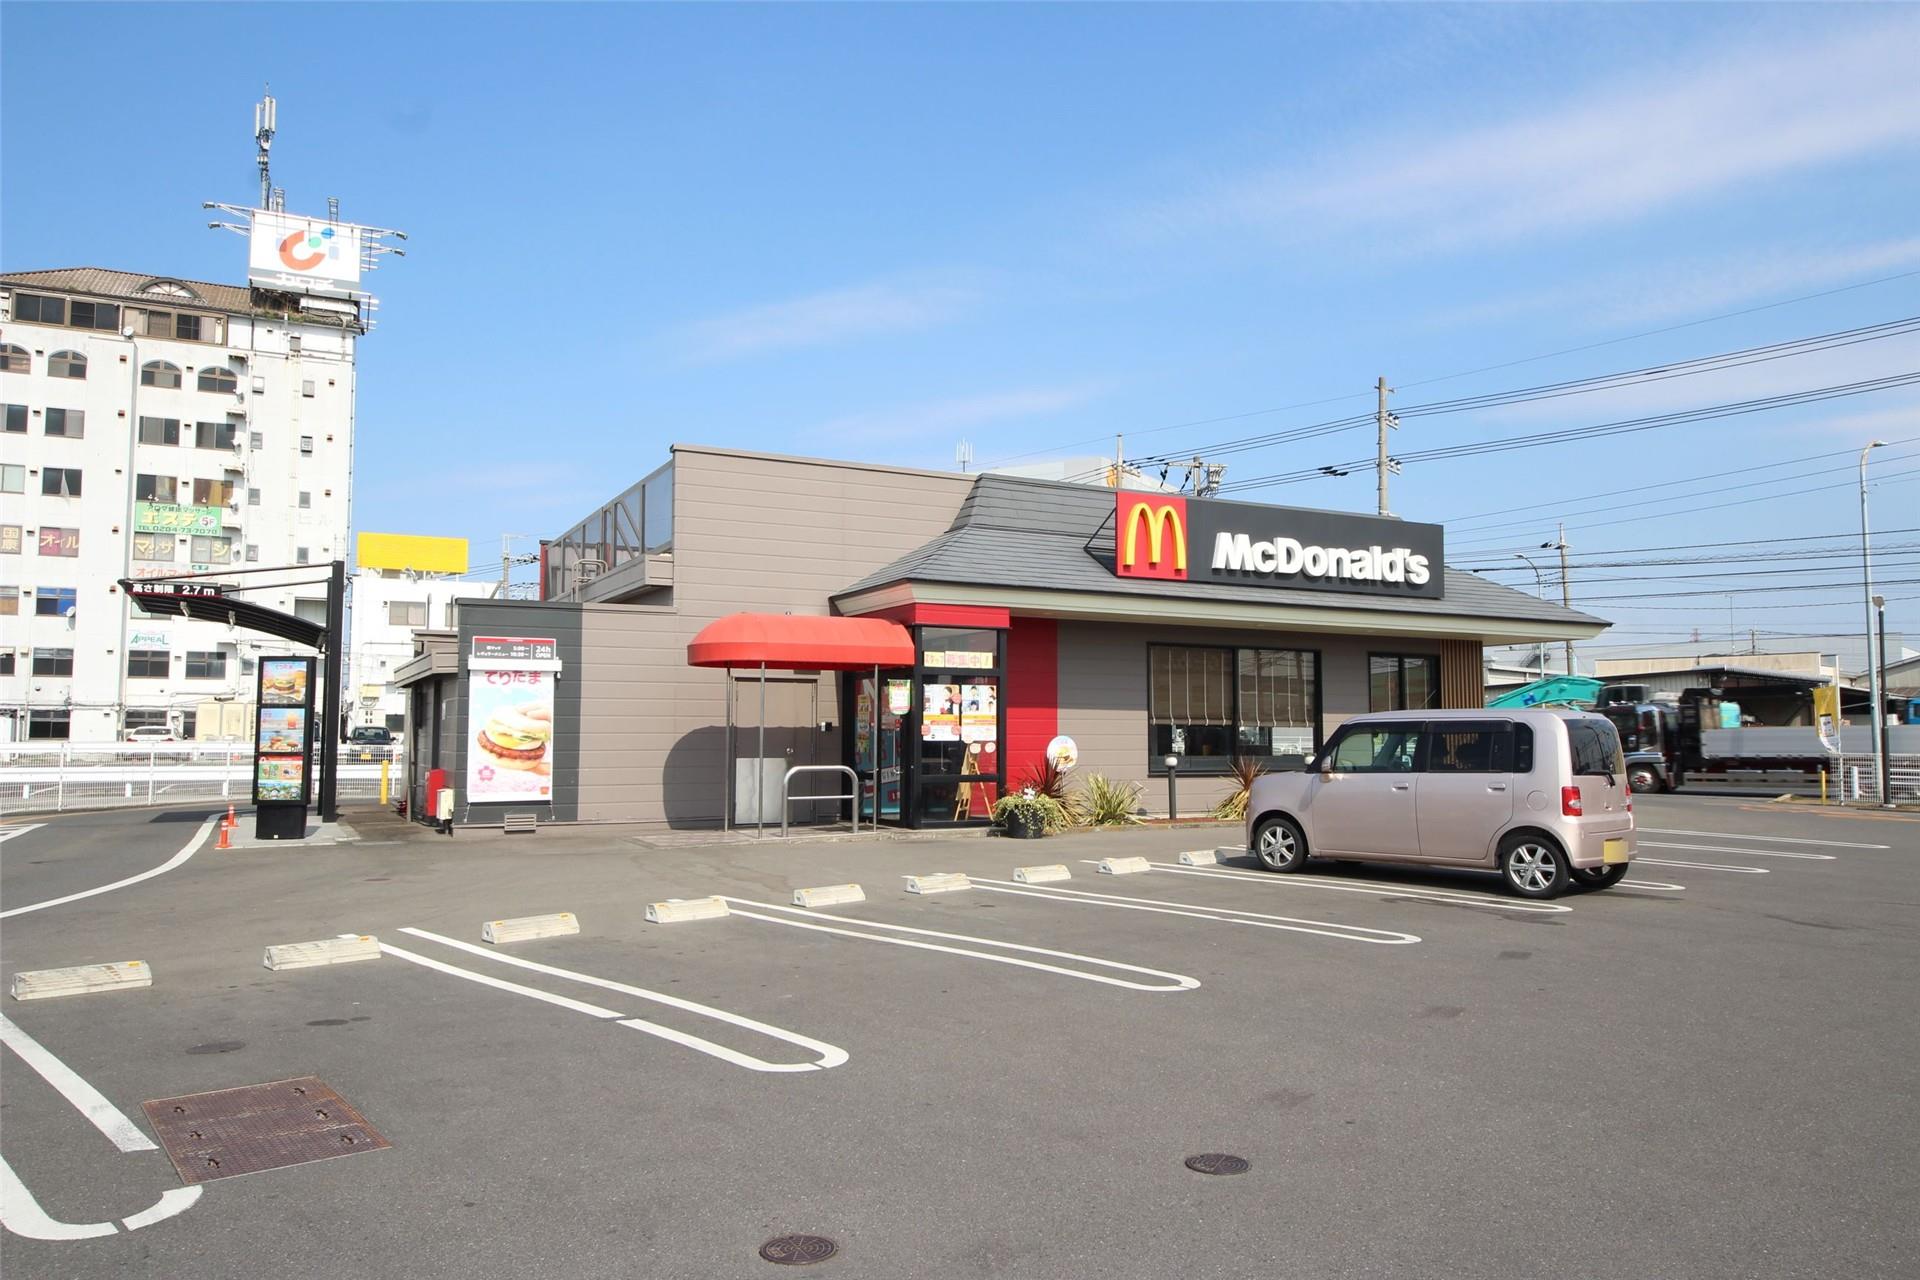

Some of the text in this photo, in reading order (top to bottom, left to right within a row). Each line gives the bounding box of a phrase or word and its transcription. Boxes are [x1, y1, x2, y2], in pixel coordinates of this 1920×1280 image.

[143, 511, 198, 527] エステ
[201, 517, 215, 526] 5F
[40, 534, 79, 549] オイル
[1212, 531, 1431, 585] McDonald's
[132, 583, 175, 594] 高さ制限
[130, 633, 169, 645] APPEAL
[535, 645, 552, 653] 24h
[484, 670, 542, 686] てりたま
